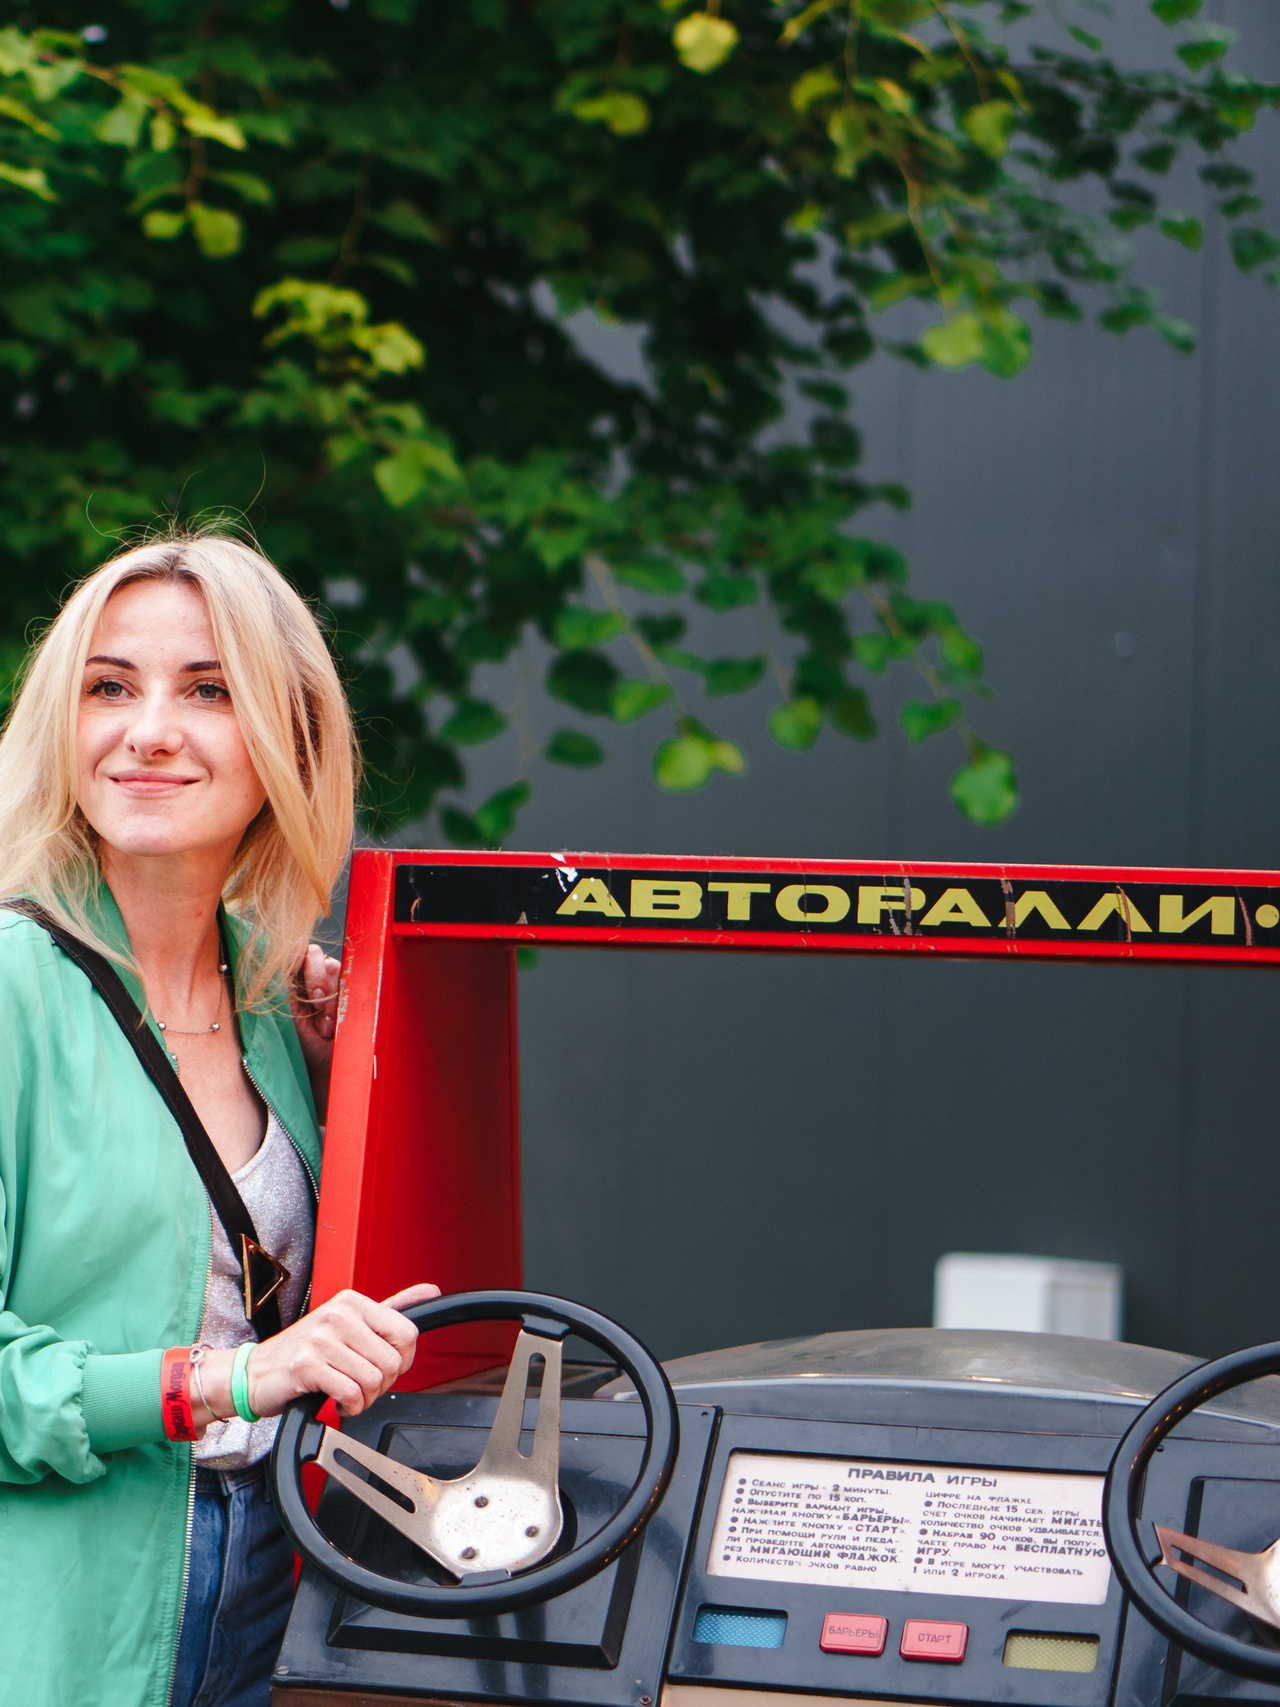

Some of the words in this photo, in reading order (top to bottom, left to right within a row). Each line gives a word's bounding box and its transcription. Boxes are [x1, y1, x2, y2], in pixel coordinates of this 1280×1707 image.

[556, 877, 1236, 936] АВТОРАЛЛИ
[166, 1362, 187, 1405] Morgan
[168, 1405, 193, 1439] Captain
[848, 1468, 936, 1484] ПРАВИЛА
[946, 1475, 997, 1487] ИГРЫ
[832, 1484, 840, 1492] 2
[829, 1493, 841, 1502] 15
[967, 1494, 981, 1502] НА
[1006, 1505, 1018, 1513] 15
[1051, 1516, 1103, 1528] МИГАТЬ
[979, 1531, 996, 1541] 90
[1015, 1543, 1106, 1558] БЕСПЛАТНУЮ
[927, 1557, 935, 1566] В
[912, 1566, 918, 1574] 1
[951, 1568, 959, 1577] 2
[828, 1625, 879, 1639] БАРЬЕРЫ
[917, 1632, 952, 1644] СТАРТ
